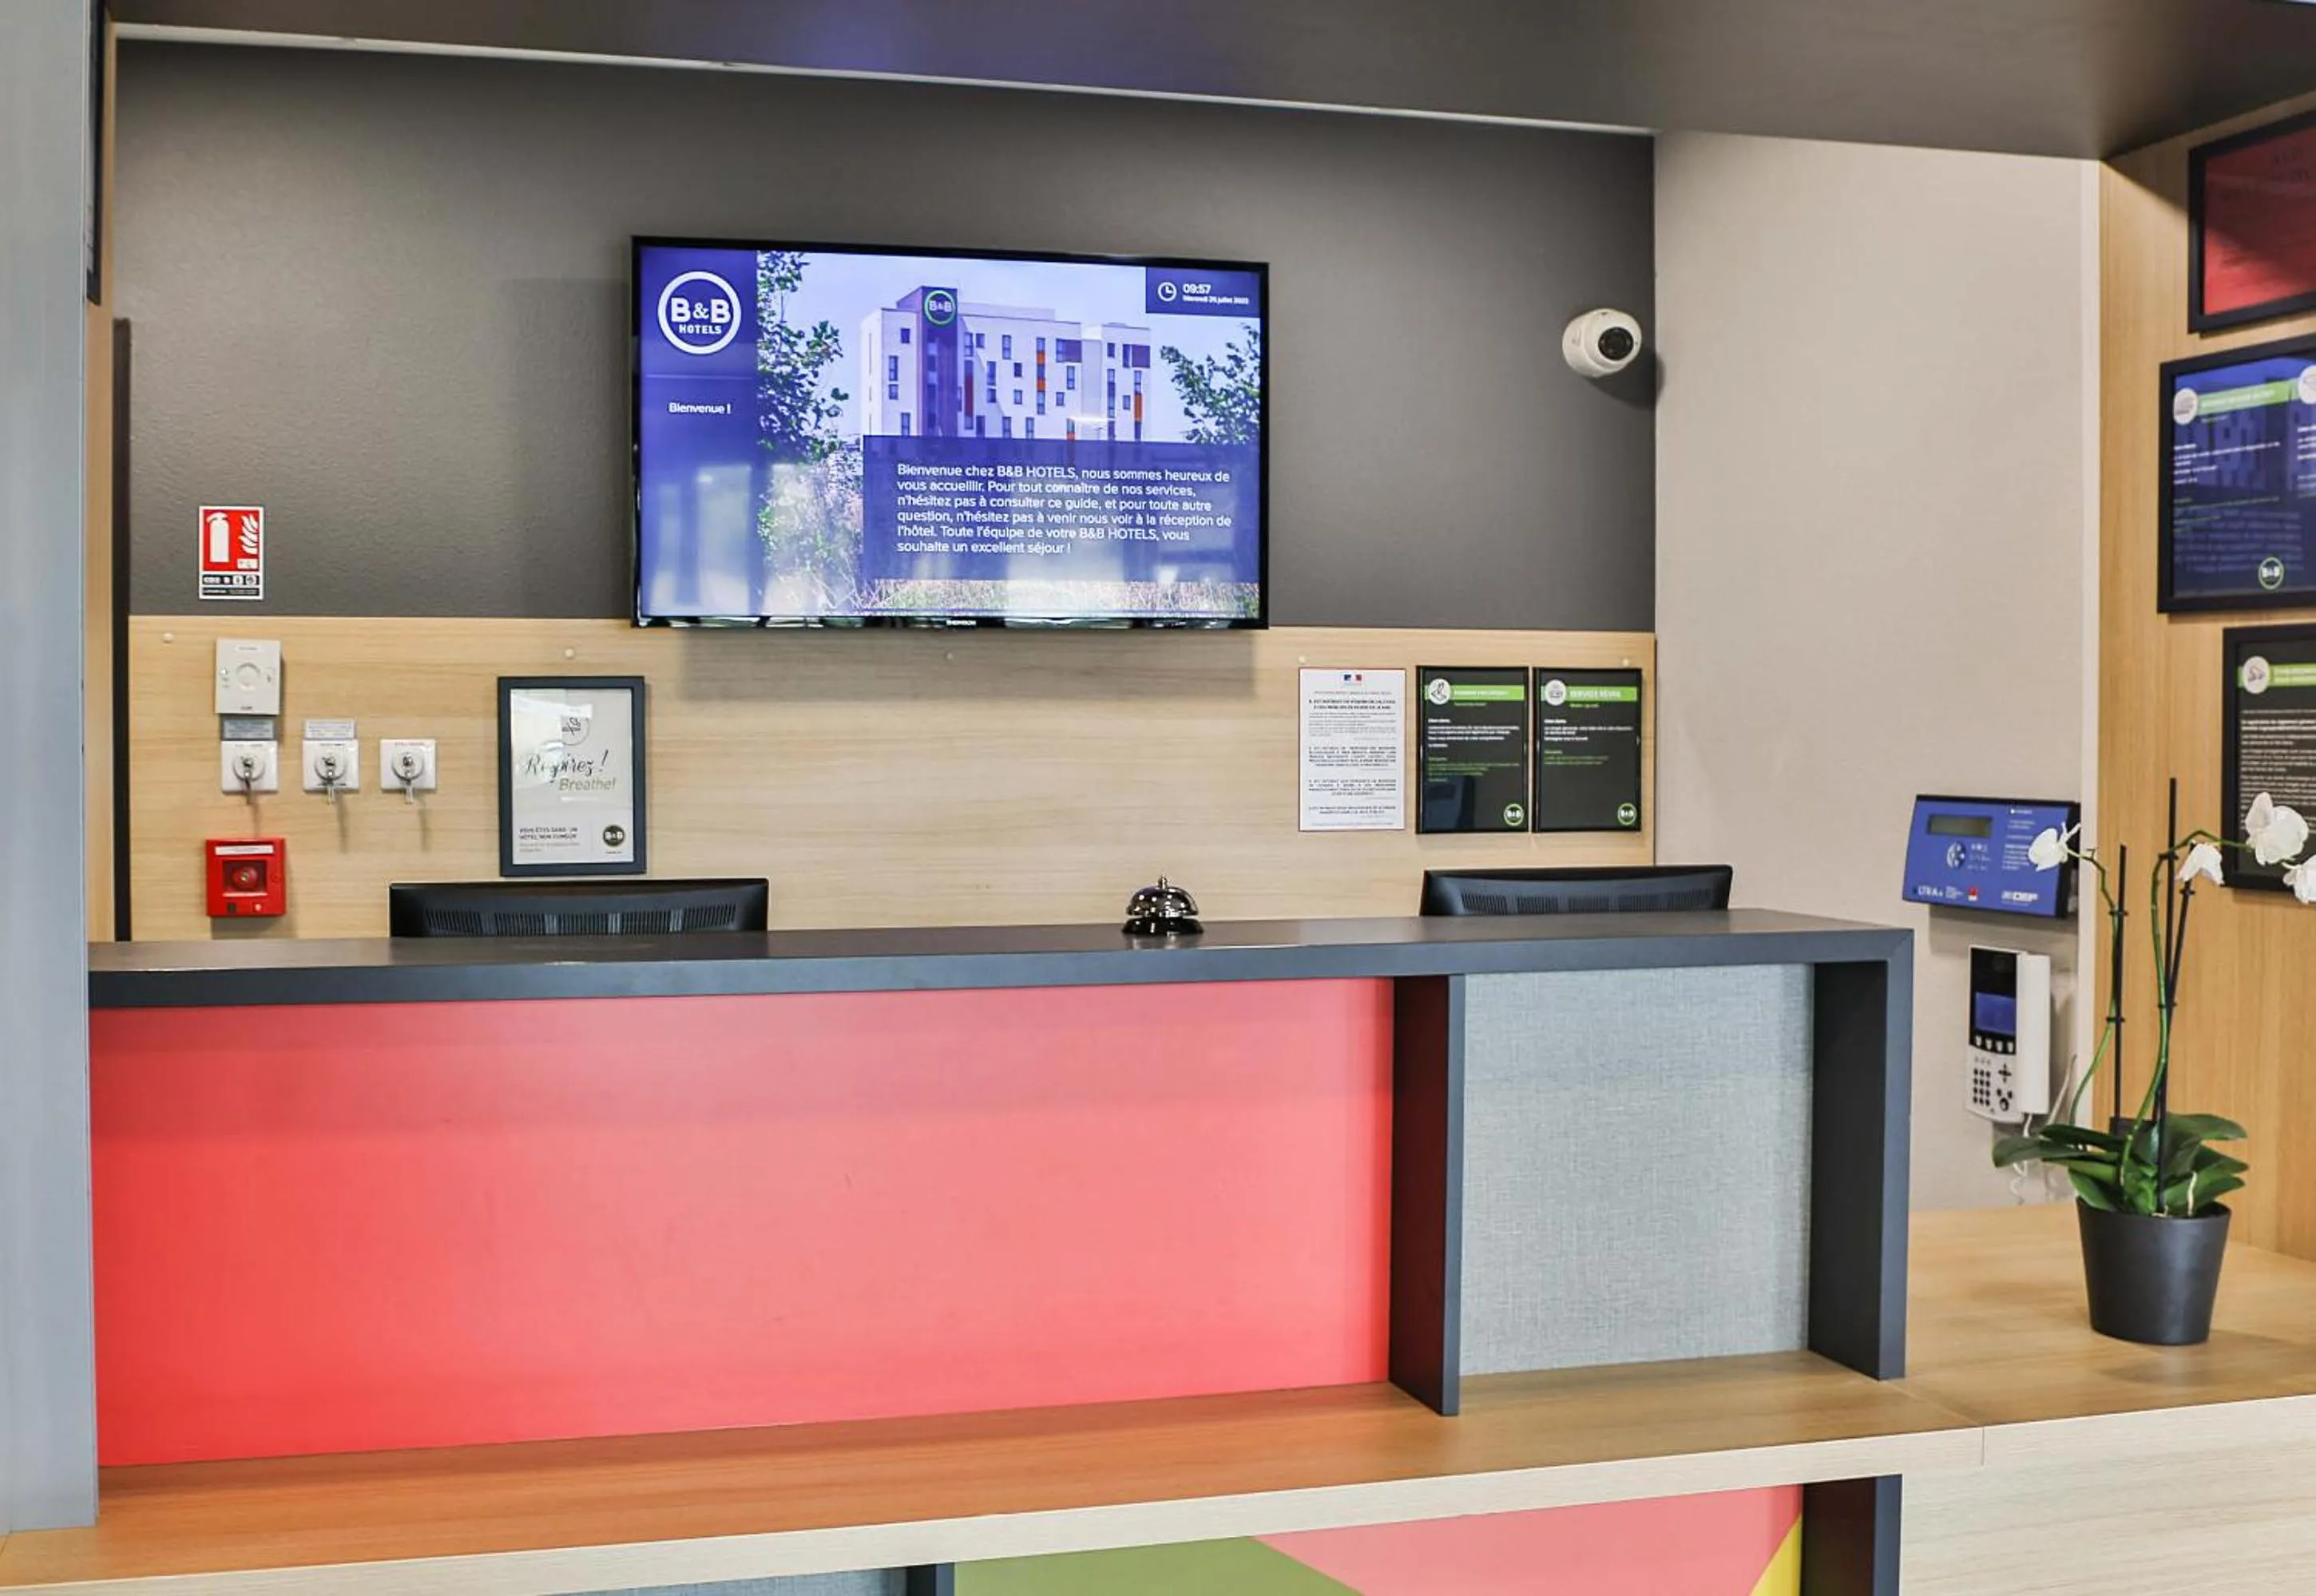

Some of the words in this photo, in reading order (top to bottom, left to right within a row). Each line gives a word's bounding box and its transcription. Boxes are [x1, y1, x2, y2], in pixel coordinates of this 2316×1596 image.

[671, 297, 731, 323] B&B
[679, 323, 722, 335] HOTELS
[668, 402, 725, 414] Bienvenue
[898, 464, 962, 476] Bienvenue
[965, 465, 994, 477] chez
[997, 465, 1023, 477] B&B
[1026, 466, 1077, 480] HOTELS,
[1082, 469, 1110, 479] nous
[1113, 470, 1161, 480] sommes
[1165, 469, 1212, 481] heureux
[1215, 470, 1230, 482] de
[897, 481, 926, 490] vous
[930, 481, 984, 492] accueillir.
[988, 481, 1016, 492] Pour
[1018, 482, 1042, 493] tout
[1045, 482, 1100, 494] connaître
[1103, 483, 1118, 494] de
[1121, 485, 1143, 495] nos
[1145, 485, 1196, 497] services,
[898, 495, 951, 507] n'hésitez
[954, 497, 976, 509] pas
[989, 497, 1045, 508] consulter
[1048, 499, 1062, 508] ce
[1065, 498, 1101, 511] guide,
[1105, 500, 1116, 509] et
[1120, 501, 1146, 511] pour
[1148, 501, 1179, 510] toute
[1182, 501, 1212, 511] autre
[898, 511, 954, 523] question,
[956, 511, 1009, 523] n'hésitez
[1012, 513, 1033, 524] pas
[1048, 513, 1077, 524] venir
[1080, 514, 1108, 524] nous
[1111, 514, 1133, 525] voir
[1146, 514, 1156, 525] la
[1160, 514, 1213, 527] réception
[1216, 516, 1231, 527] de
[898, 525, 938, 537] l'hôtel.
[941, 526, 974, 537] Toute
[977, 526, 1024, 538] l'équipe
[1027, 527, 1043, 538] de
[1046, 529, 1077, 539] votre
[1080, 528, 1104, 540] B&B
[1108, 529, 1160, 541] HOTELS,
[1162, 531, 1190, 541] vous
[897, 541, 950, 552] souhaite
[953, 543, 968, 552] un
[971, 541, 1025, 553] excellent
[1028, 543, 1065, 556] séjour
[559, 778, 616, 791] Breathe!
